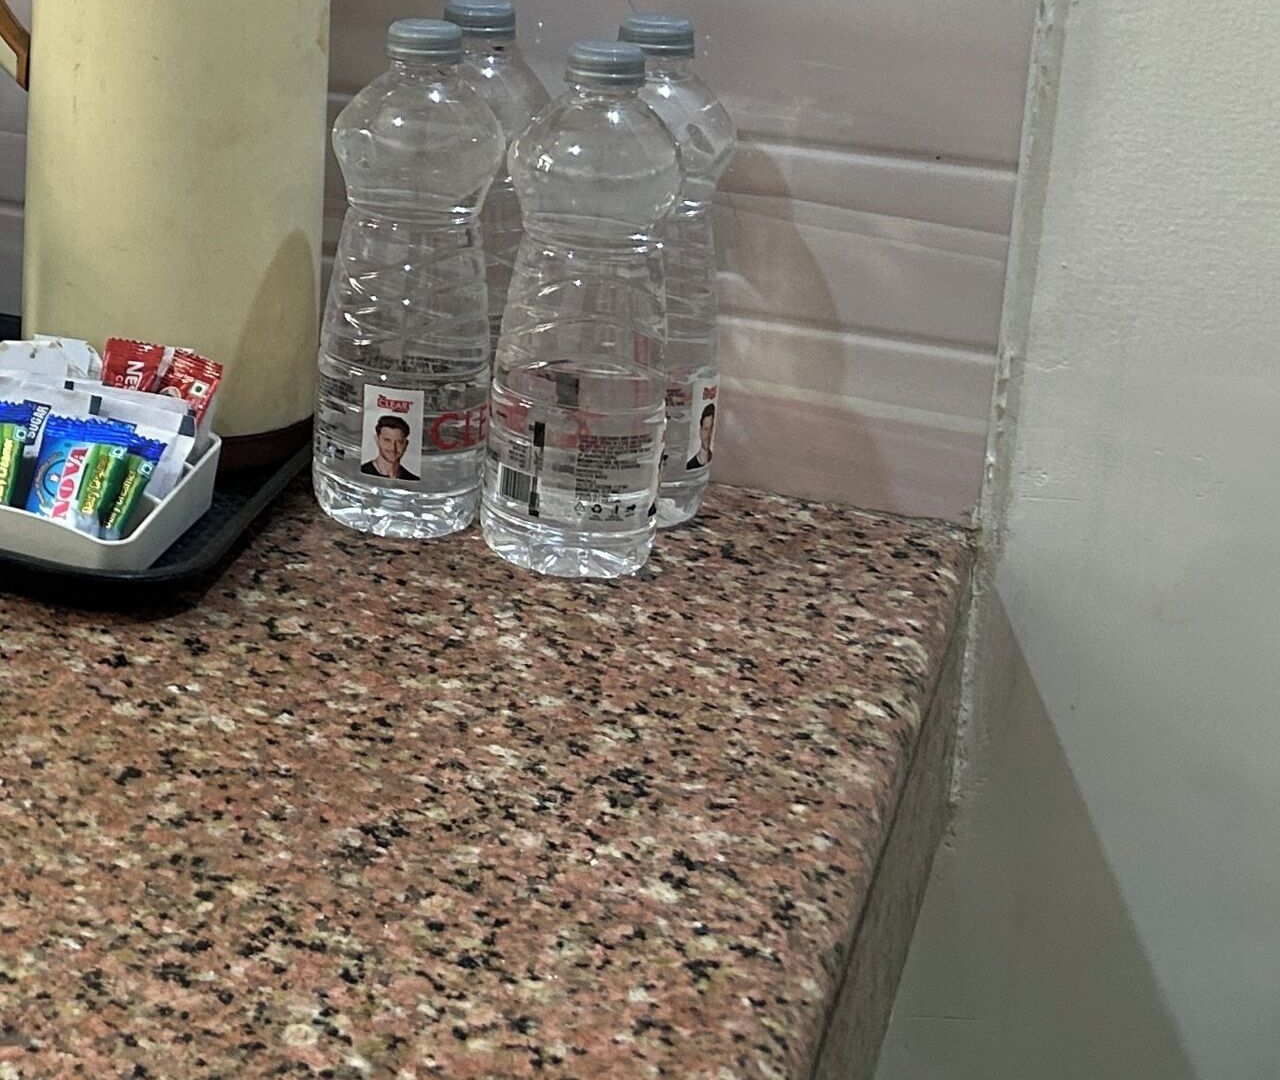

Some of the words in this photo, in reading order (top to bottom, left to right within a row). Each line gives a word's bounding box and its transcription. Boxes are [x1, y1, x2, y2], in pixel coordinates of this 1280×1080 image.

[26, 404, 50, 440] SUGAR
[377, 398, 410, 411] CLEAR
[51, 446, 90, 521] NOVA
